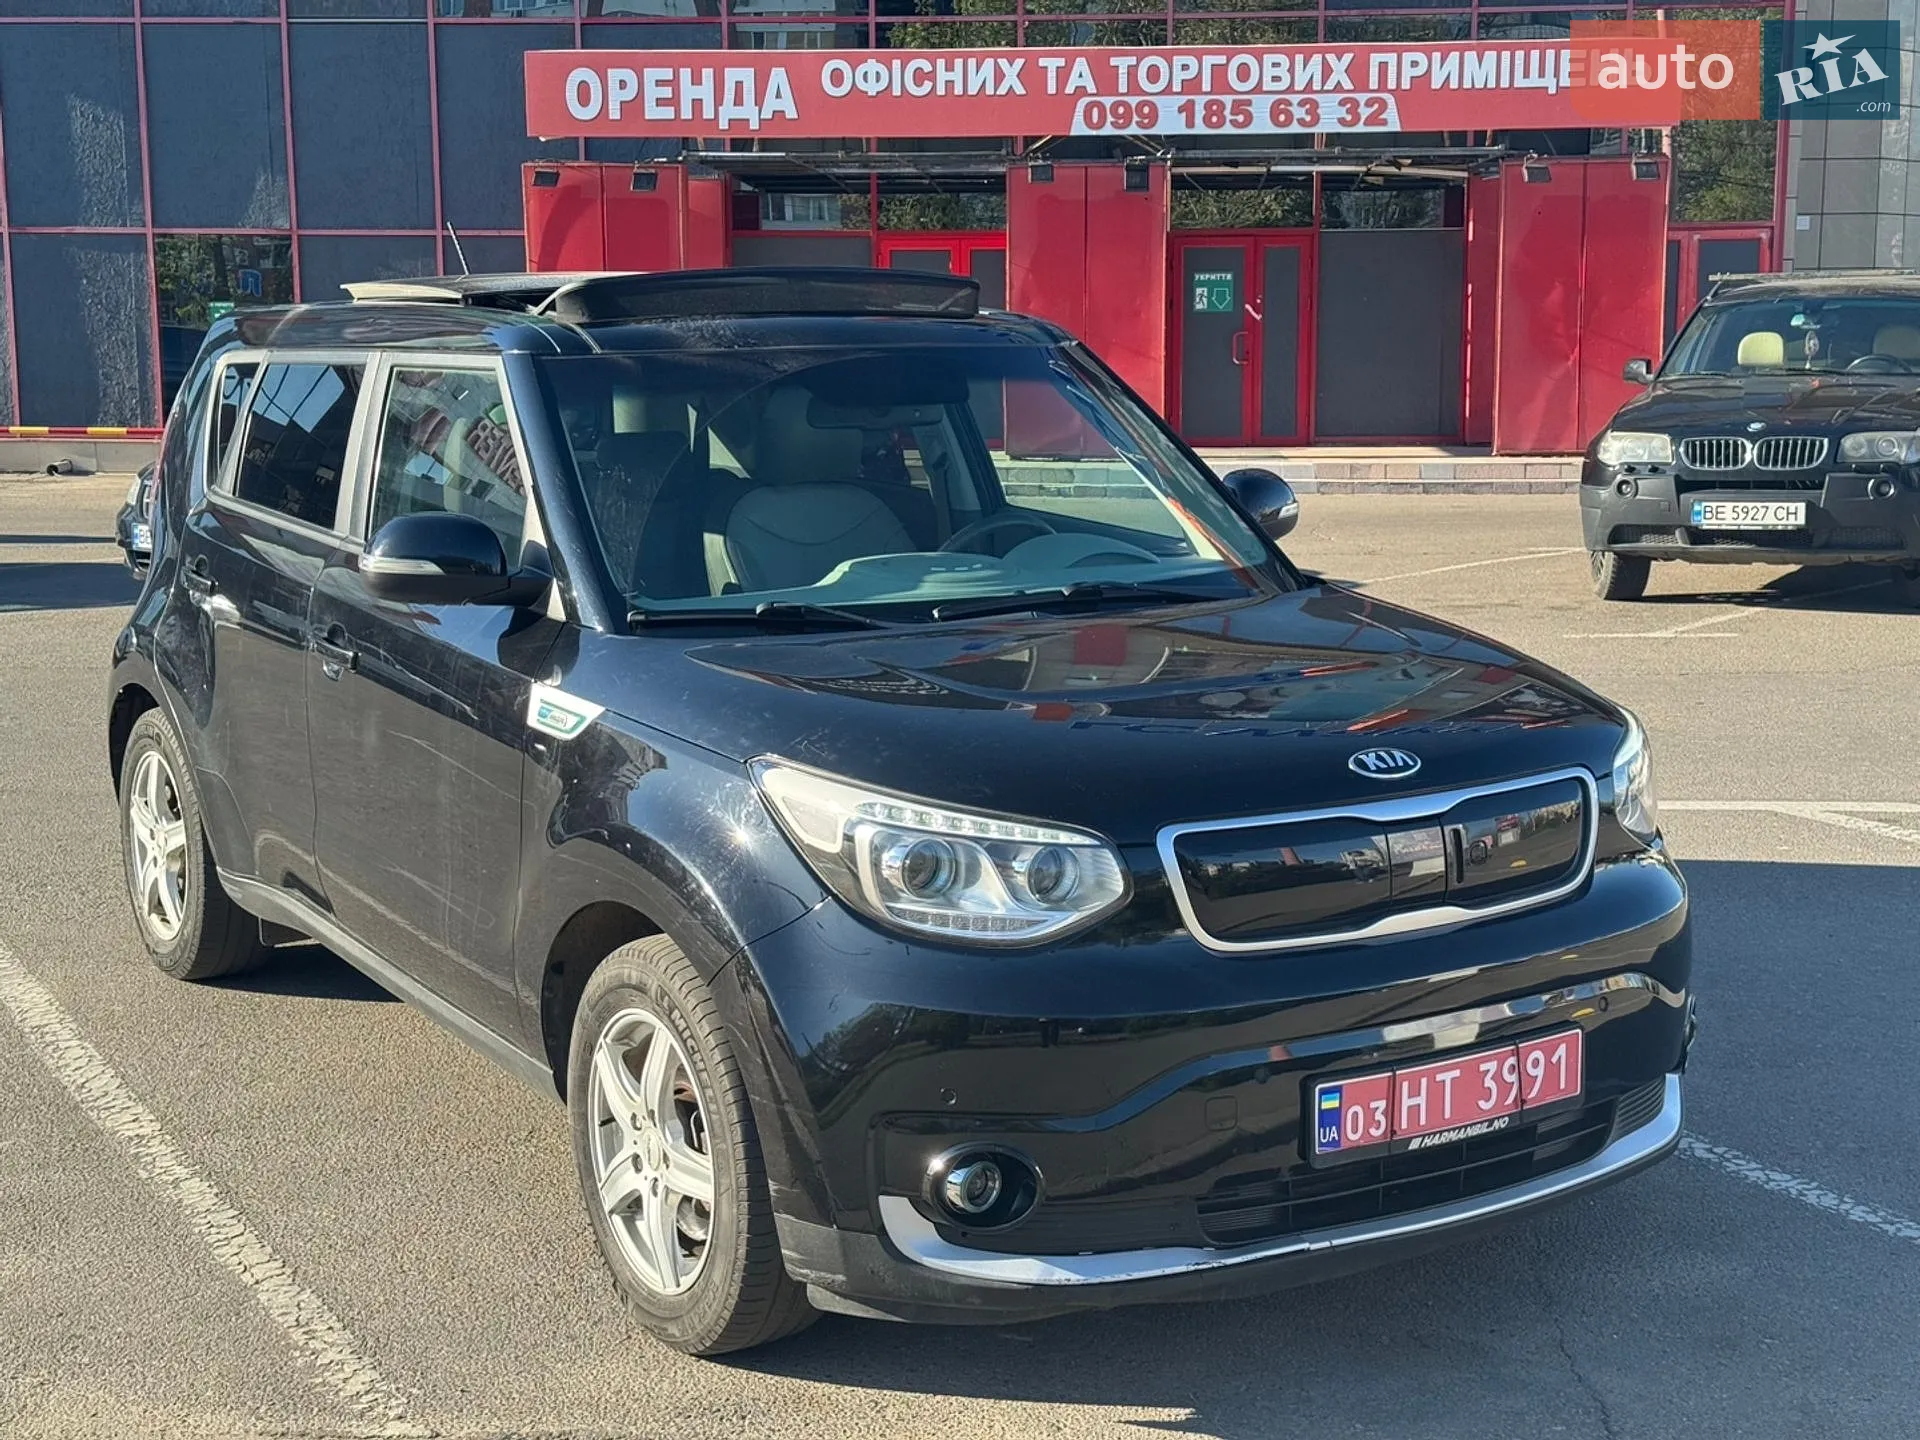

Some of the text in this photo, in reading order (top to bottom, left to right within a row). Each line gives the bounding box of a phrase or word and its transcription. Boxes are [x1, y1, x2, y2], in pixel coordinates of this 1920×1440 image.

[565, 67, 799, 130] ОРЕНДА
[821, 57, 1026, 97] ОФІСНИХ
[1038, 57, 1097, 95] ТА
[1110, 53, 1355, 94] ТОРГОВИХ
[1082, 96, 1388, 130] 099 185 63 32
[1703, 505, 1798, 521] BE 5927 CH
[1358, 750, 1414, 771] KIA
[1345, 1043, 1567, 1142] 03 HT 3991
[1320, 1128, 1339, 1143] UA
[1421, 1116, 1509, 1148] HARMANBIL.NO
